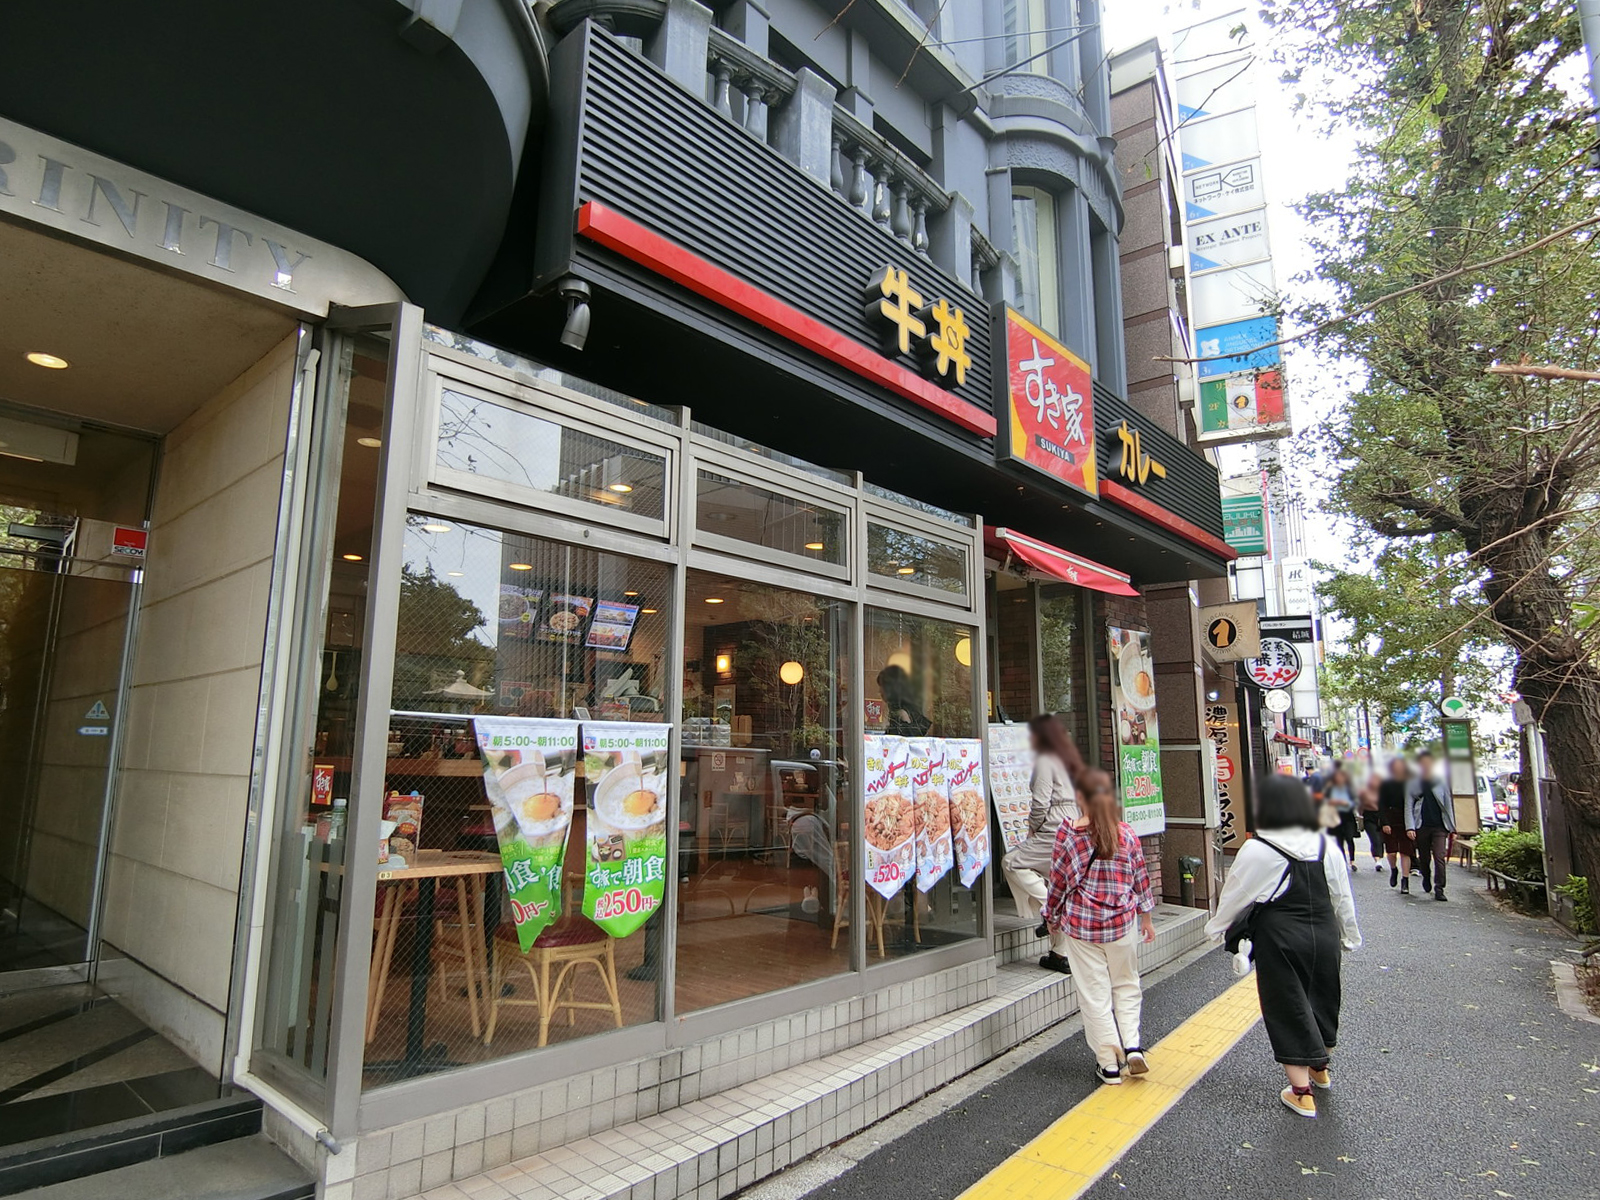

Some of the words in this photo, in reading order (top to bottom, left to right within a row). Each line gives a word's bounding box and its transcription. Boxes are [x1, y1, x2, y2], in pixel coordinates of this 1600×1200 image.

[1195, 232, 1215, 246] EX
[1221, 221, 1262, 241] ANTE
[880, 265, 972, 386] 牛丼
[1018, 338, 1087, 446] すき家
[1040, 437, 1071, 462] SUKIYA
[1119, 420, 1167, 486] カレー
[114, 545, 144, 556] SECOM
[1254, 667, 1298, 686] ラーメン
[589, 855, 665, 889] すき家で朝食
